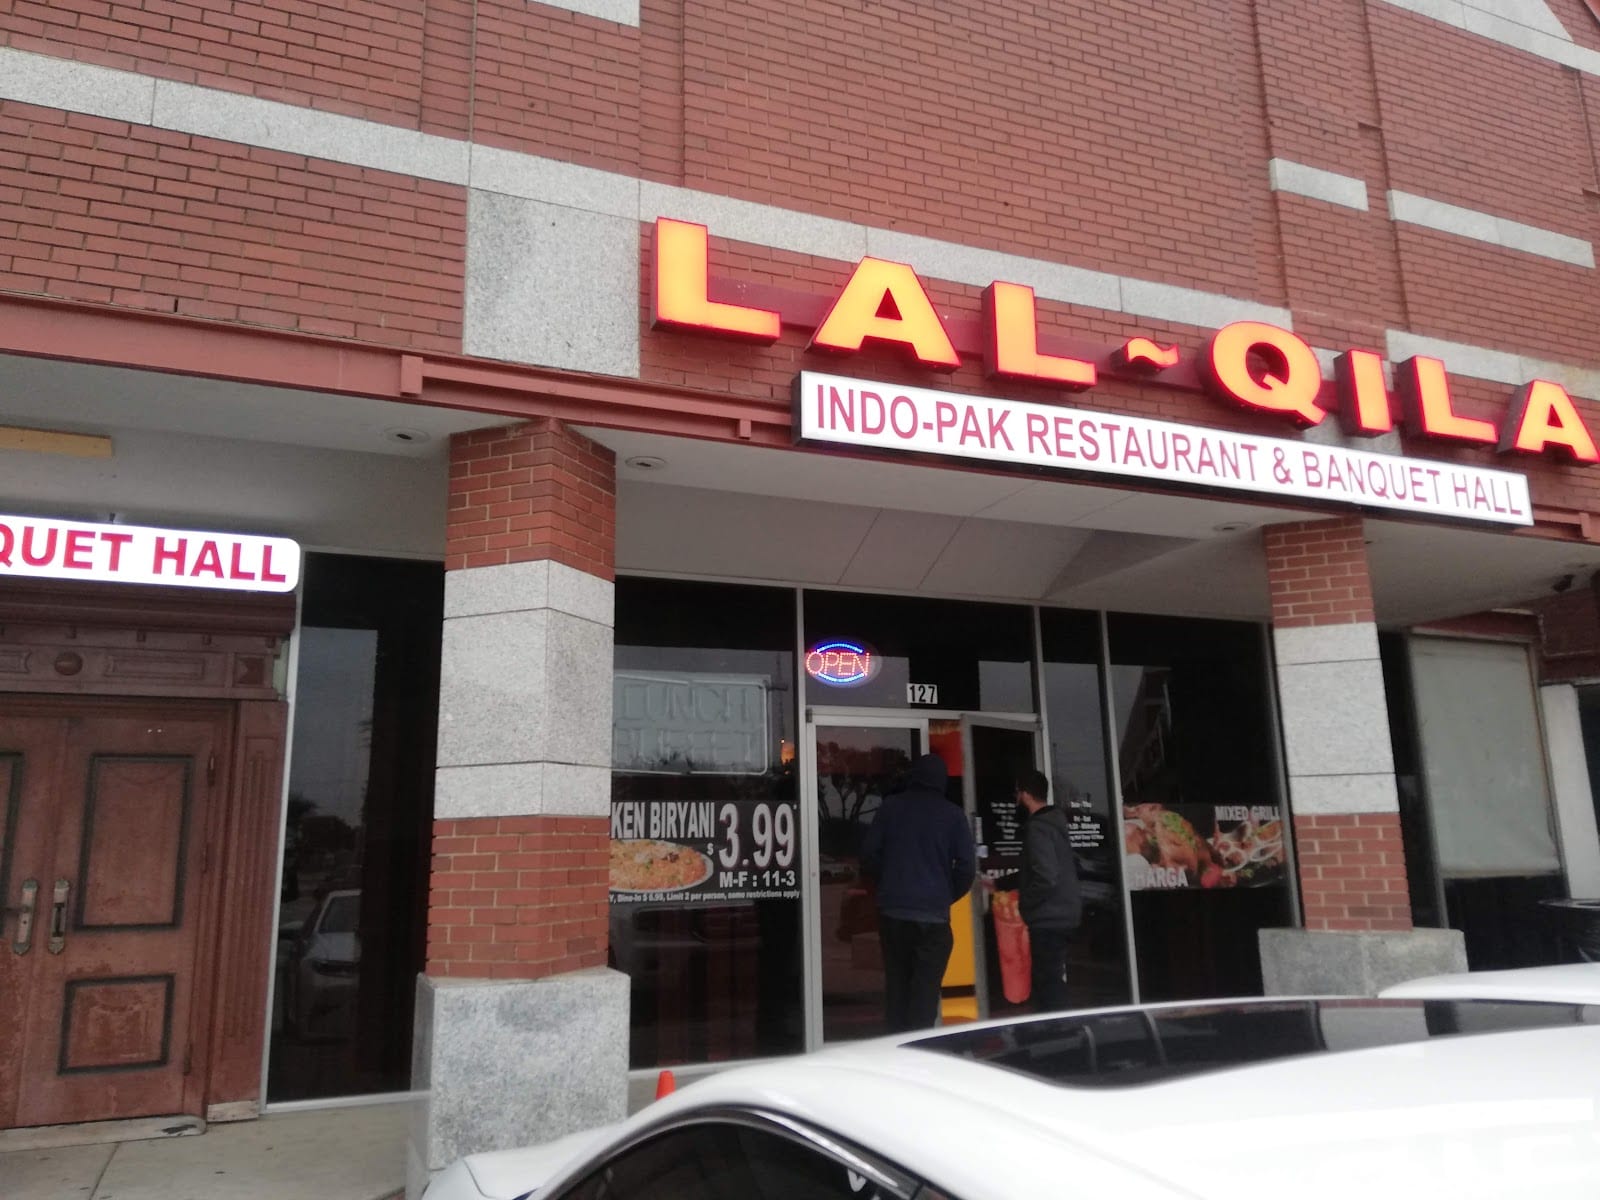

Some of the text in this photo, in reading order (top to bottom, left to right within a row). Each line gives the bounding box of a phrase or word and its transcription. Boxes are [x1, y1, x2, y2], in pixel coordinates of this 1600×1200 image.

[816, 384, 1523, 515] INDO-PAK RESTAURANT & BANQUET HALL
[152, 536, 286, 583] HALL
[806, 651, 870, 676] OPEN
[909, 685, 937, 703] 127
[611, 802, 715, 839] KEN BIRYANI
[1215, 805, 1280, 821] MIXED GRILL
[763, 870, 796, 887] 11-3
